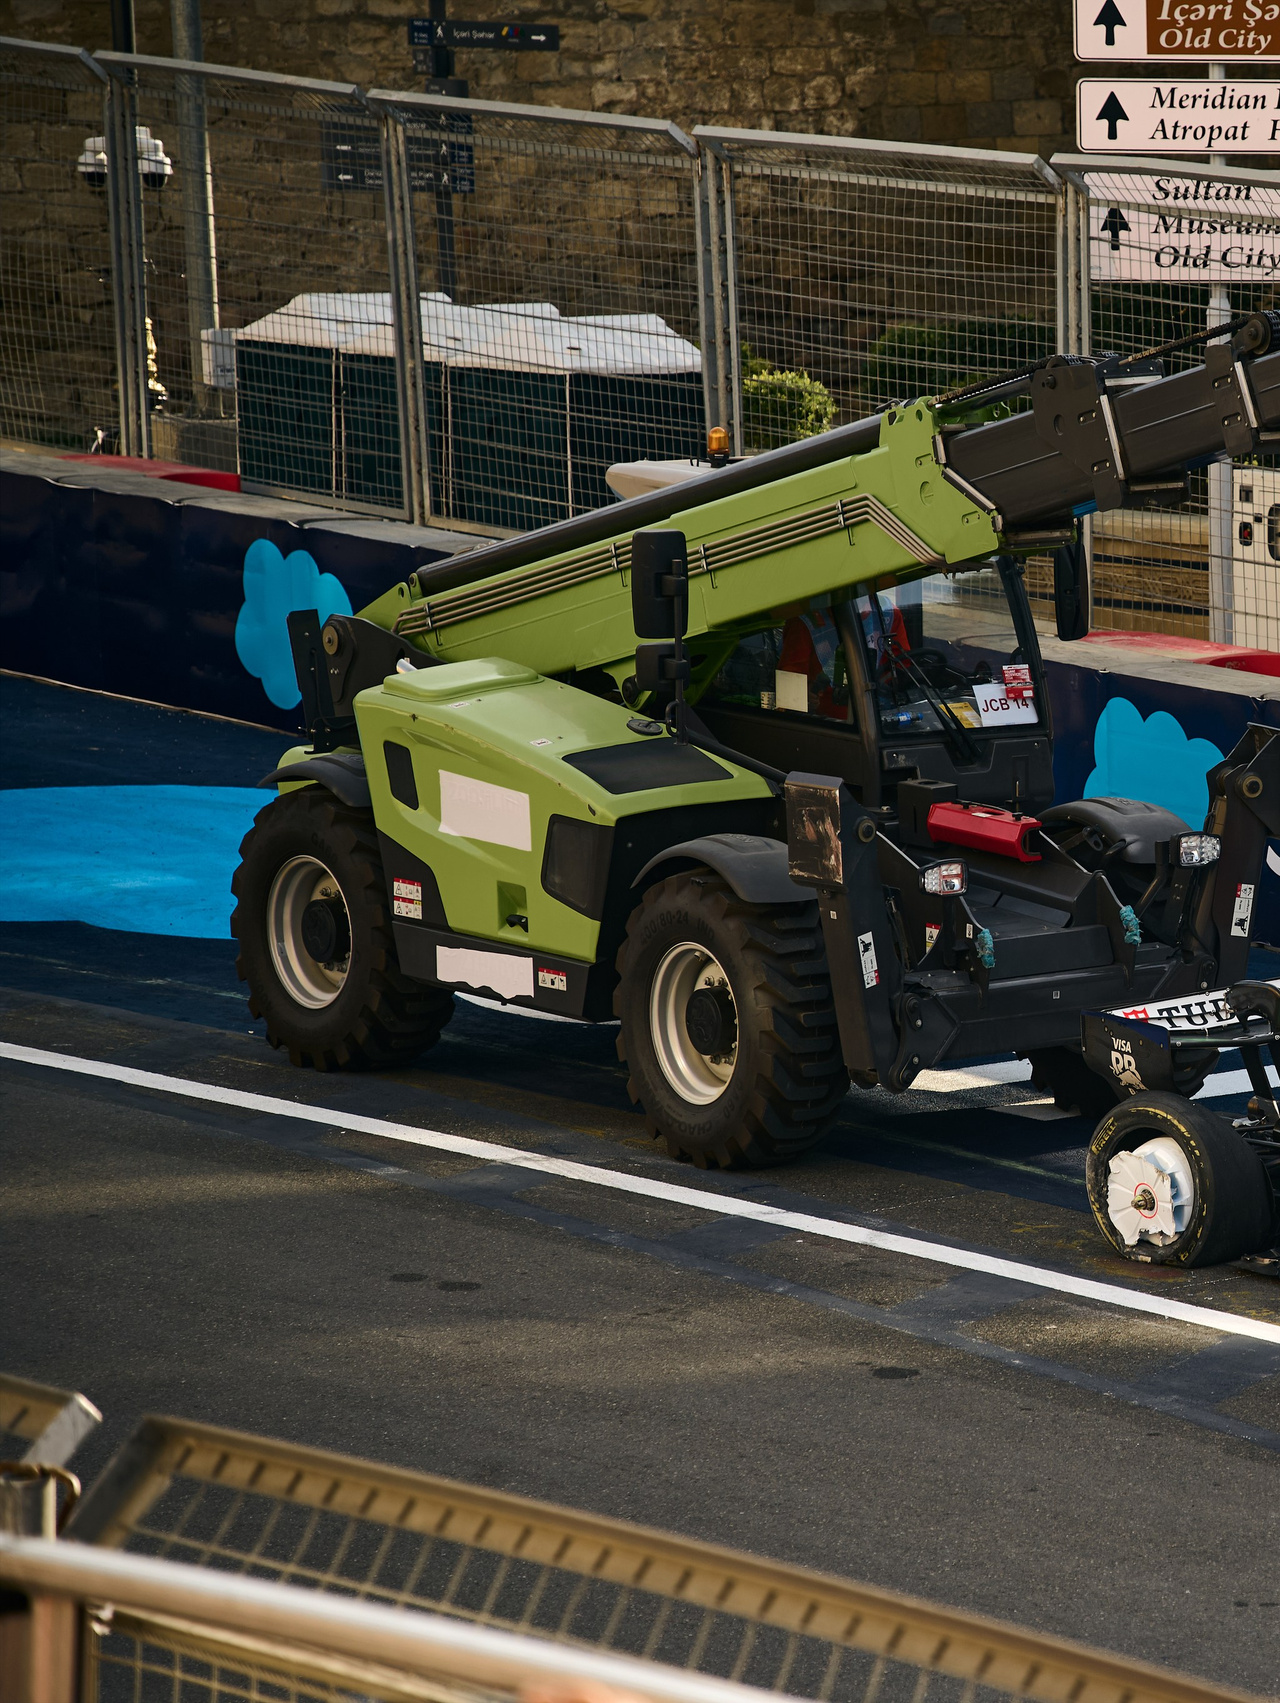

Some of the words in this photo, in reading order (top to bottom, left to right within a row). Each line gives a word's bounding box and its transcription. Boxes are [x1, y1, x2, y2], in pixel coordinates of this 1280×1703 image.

[1159, 28, 1210, 49] Old
[1218, 30, 1272, 55] City
[1148, 87, 1267, 110] Meridian
[1148, 118, 1250, 148] Atropat
[1152, 179, 1251, 201] Sultan
[1153, 215, 1280, 235] Museum
[1154, 246, 1210, 269] Old
[982, 697, 1010, 713] JCB
[1013, 698, 1029, 709] 14
[1111, 1037, 1132, 1054] VISA
